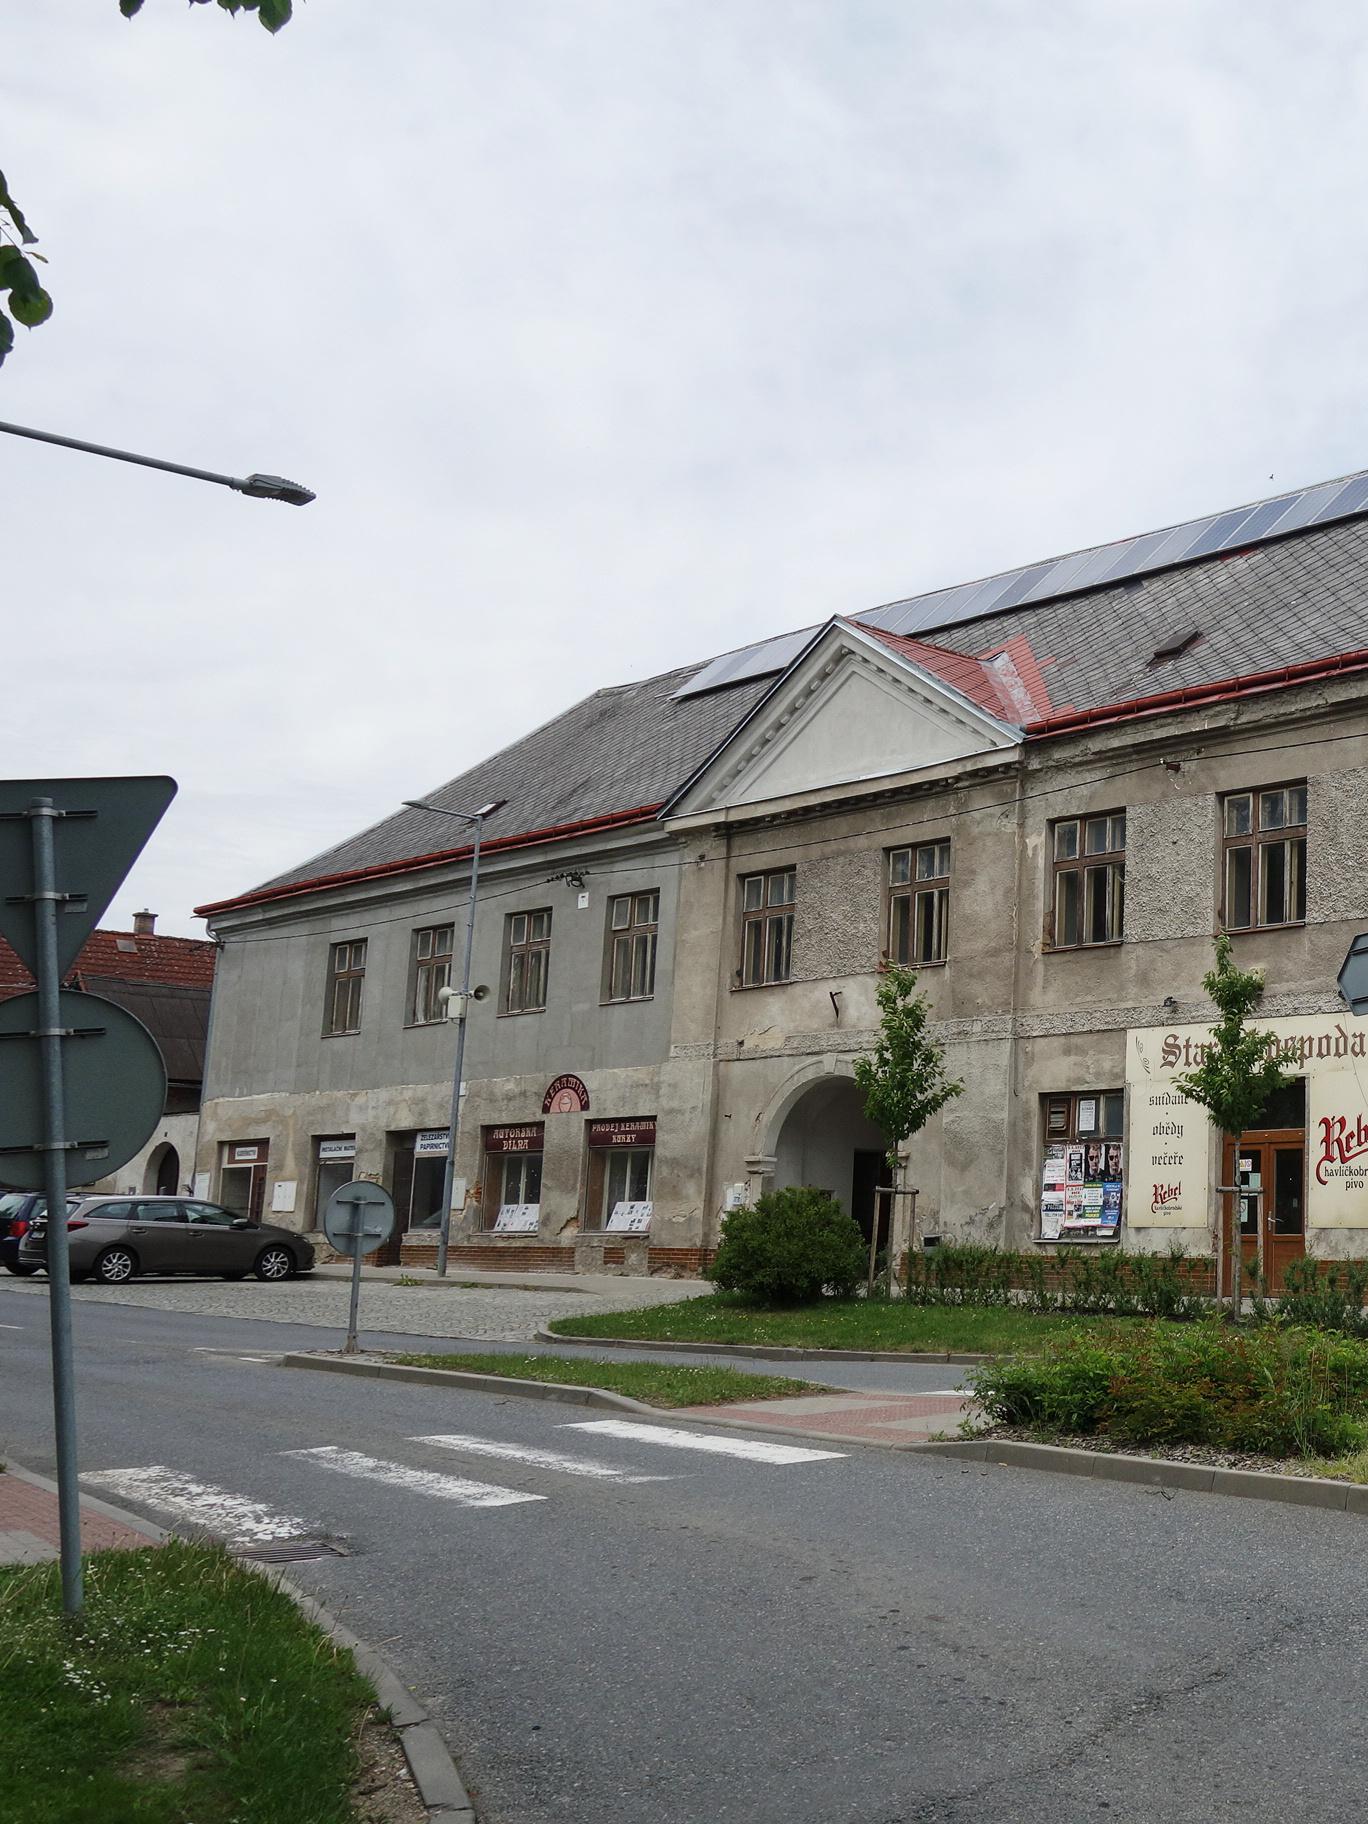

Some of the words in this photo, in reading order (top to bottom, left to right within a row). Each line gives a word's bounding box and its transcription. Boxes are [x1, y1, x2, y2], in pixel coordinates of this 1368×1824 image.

[1160, 1033, 1222, 1069] Star
[1256, 1023, 1367, 1070] ospoda
[1152, 1121, 1184, 1139] obědy
[1151, 1152, 1184, 1166] večeře
[1345, 1179, 1364, 1191] pivo
[1150, 1180, 1182, 1214] Rebel
